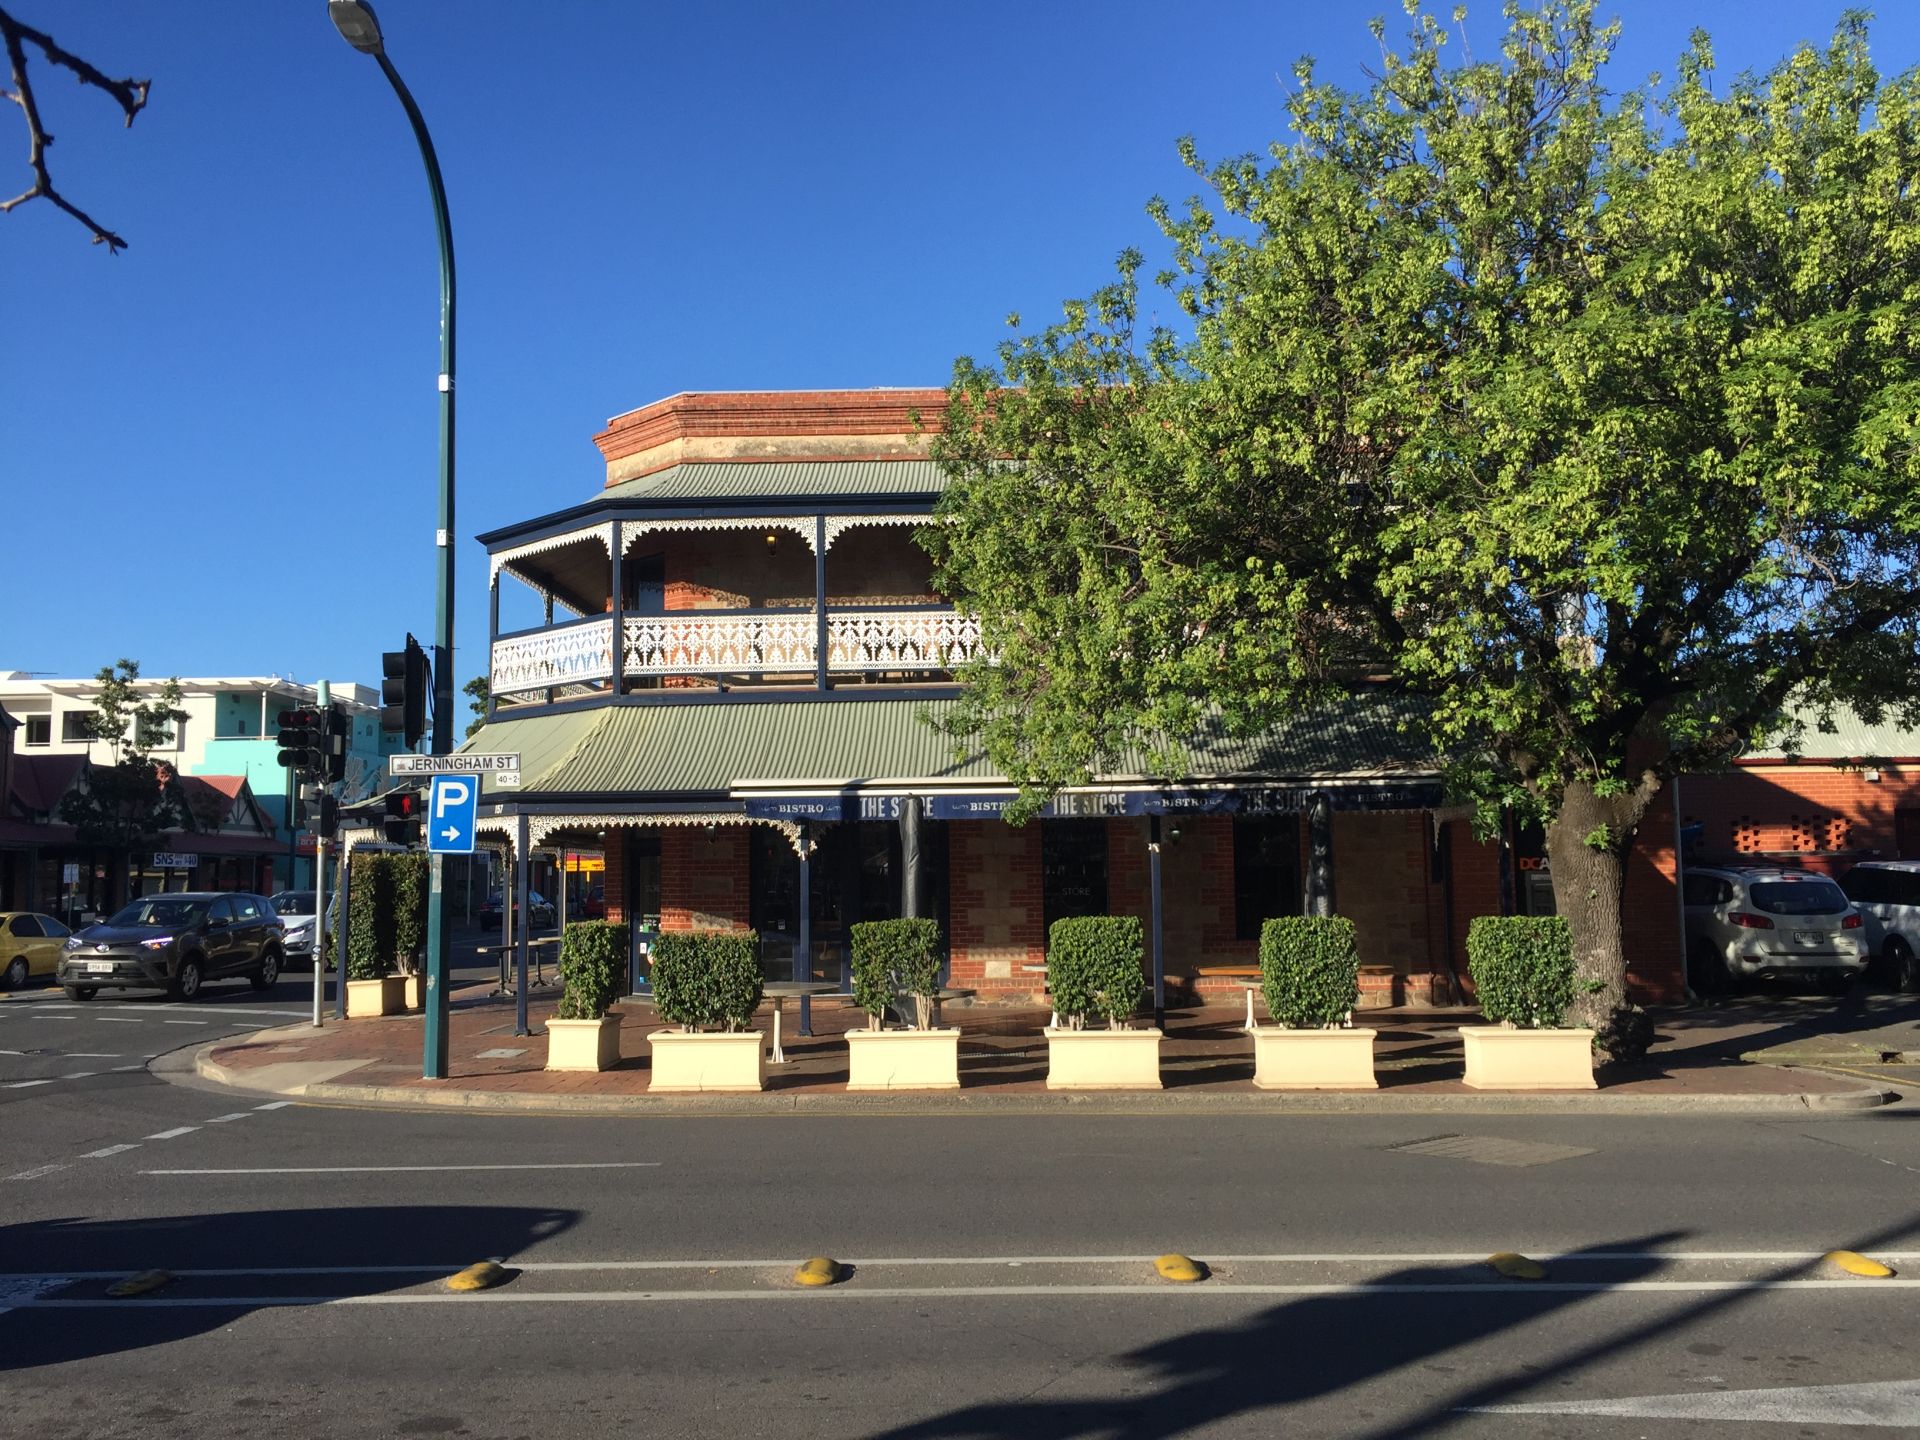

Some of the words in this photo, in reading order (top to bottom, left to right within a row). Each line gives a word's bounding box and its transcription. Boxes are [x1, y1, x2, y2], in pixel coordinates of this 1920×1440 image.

[408, 757, 492, 771] JERNINGHAM
[496, 757, 513, 769] ST
[436, 782, 469, 818] P
[970, 801, 1012, 811] BISTR
[1053, 794, 1078, 815] THE
[1083, 793, 1126, 815] STORE
[1162, 798, 1208, 807] BISTRO
[779, 804, 824, 813] BISTRO
[860, 797, 886, 818] THE
[155, 853, 174, 865] SNS
